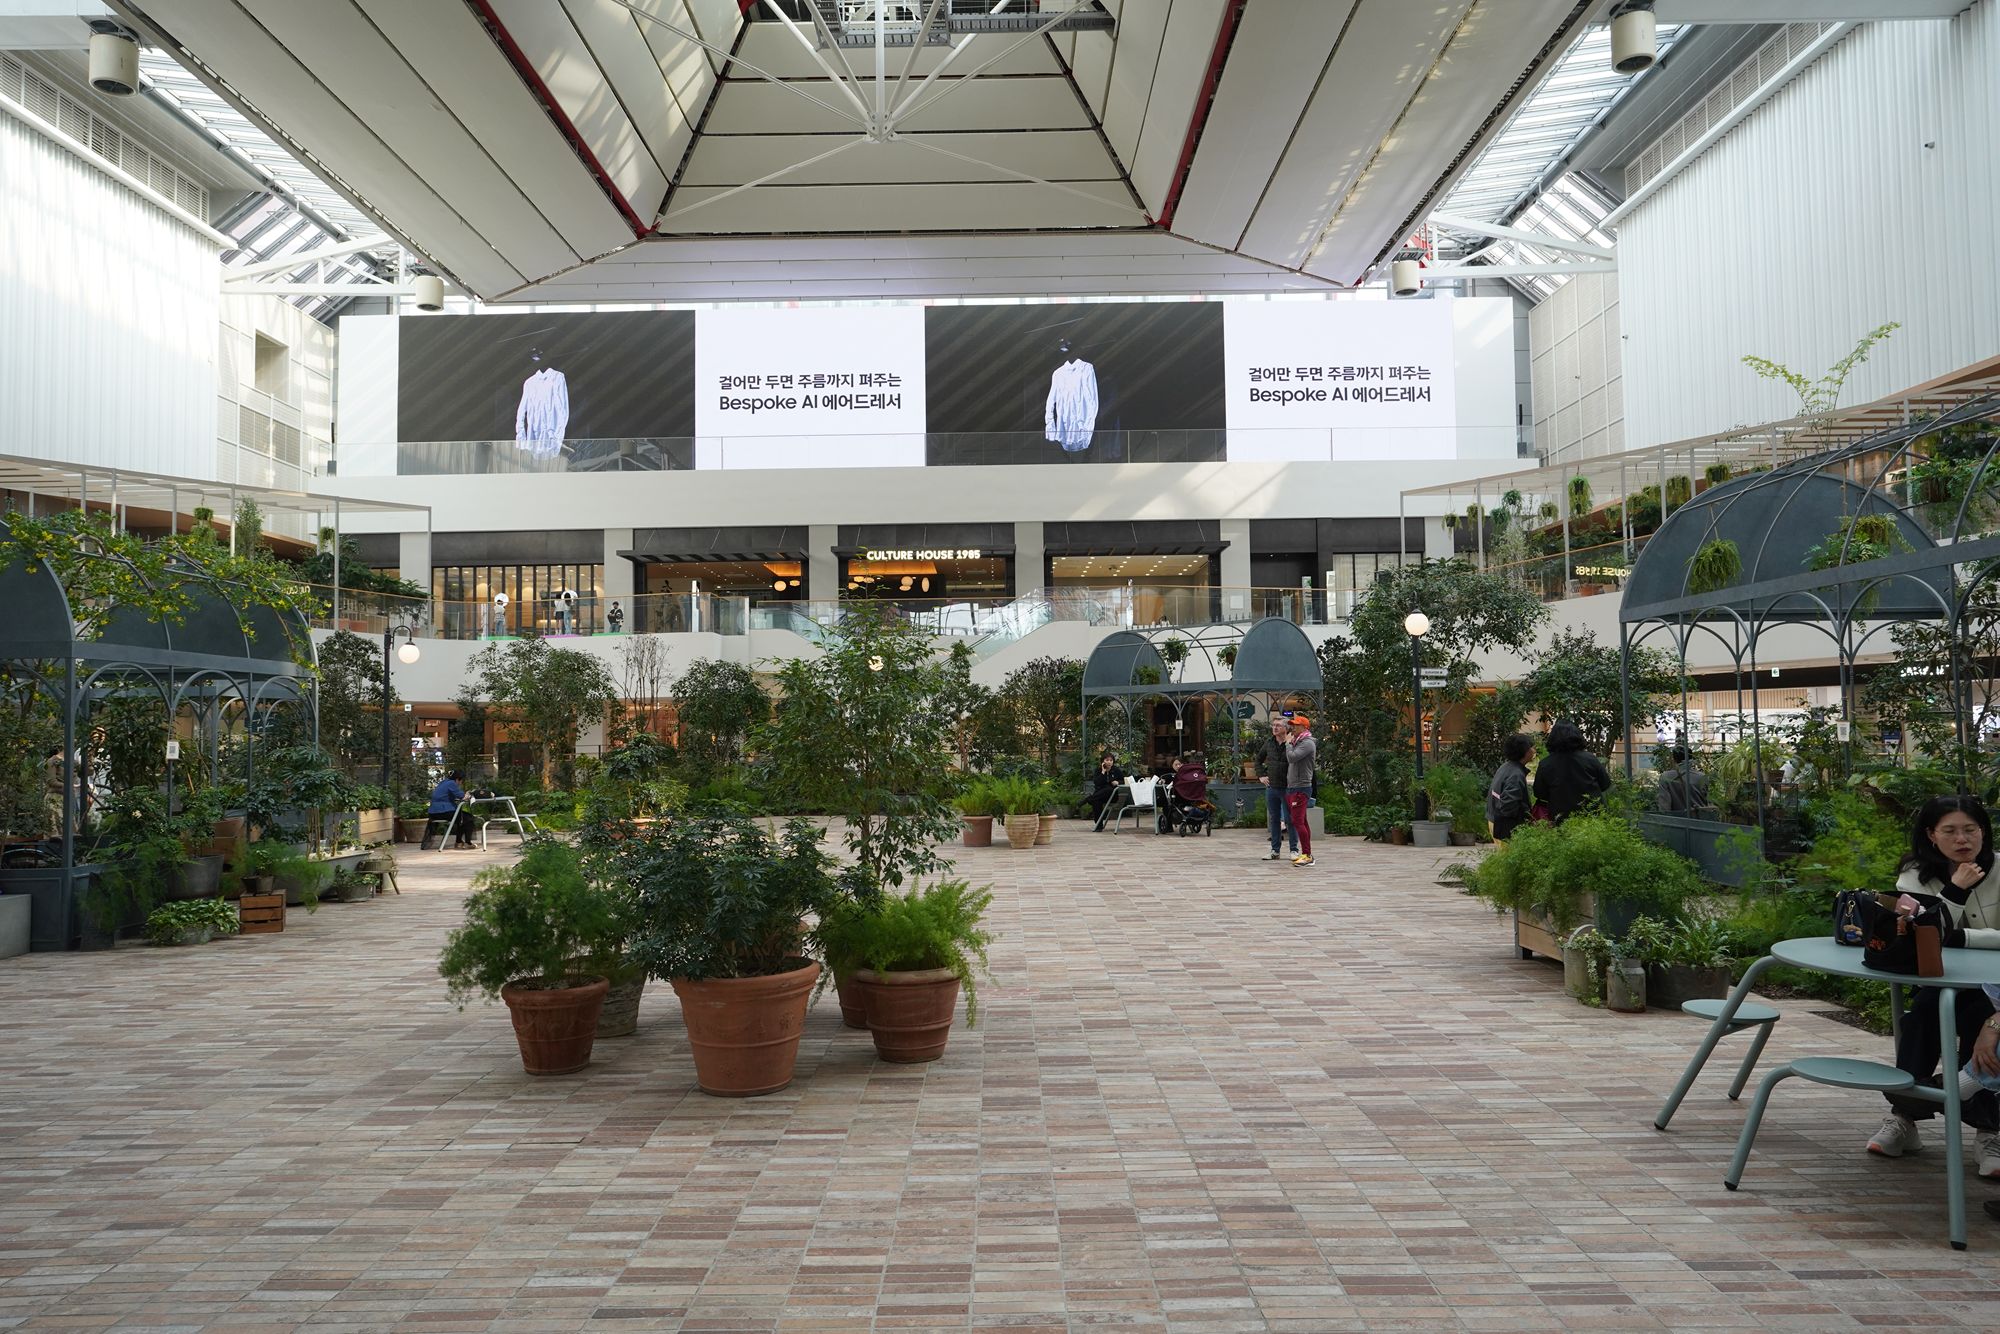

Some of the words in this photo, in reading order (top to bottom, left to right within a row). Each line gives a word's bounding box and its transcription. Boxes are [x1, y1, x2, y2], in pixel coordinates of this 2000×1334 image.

[719, 375, 762, 390] 걸어만
[764, 374, 794, 390] 두면
[797, 373, 854, 389] 주름까지
[858, 373, 902, 388] 펴주는
[1248, 367, 1292, 382] 걸어만
[1294, 366, 1324, 382] 두면
[1327, 366, 1384, 382] 주름까지
[1388, 365, 1432, 381] 펴주는
[719, 395, 798, 415] Bespoke
[801, 394, 818, 409] AI
[821, 392, 901, 410] 에어드레서
[1249, 387, 1328, 407] Bespoke
[1331, 386, 1348, 401] AI
[1351, 385, 1431, 403] 에어드레서
[866, 550, 914, 561] CULTURE
[915, 550, 954, 560] HOUSE
[956, 549, 981, 560] 1985
